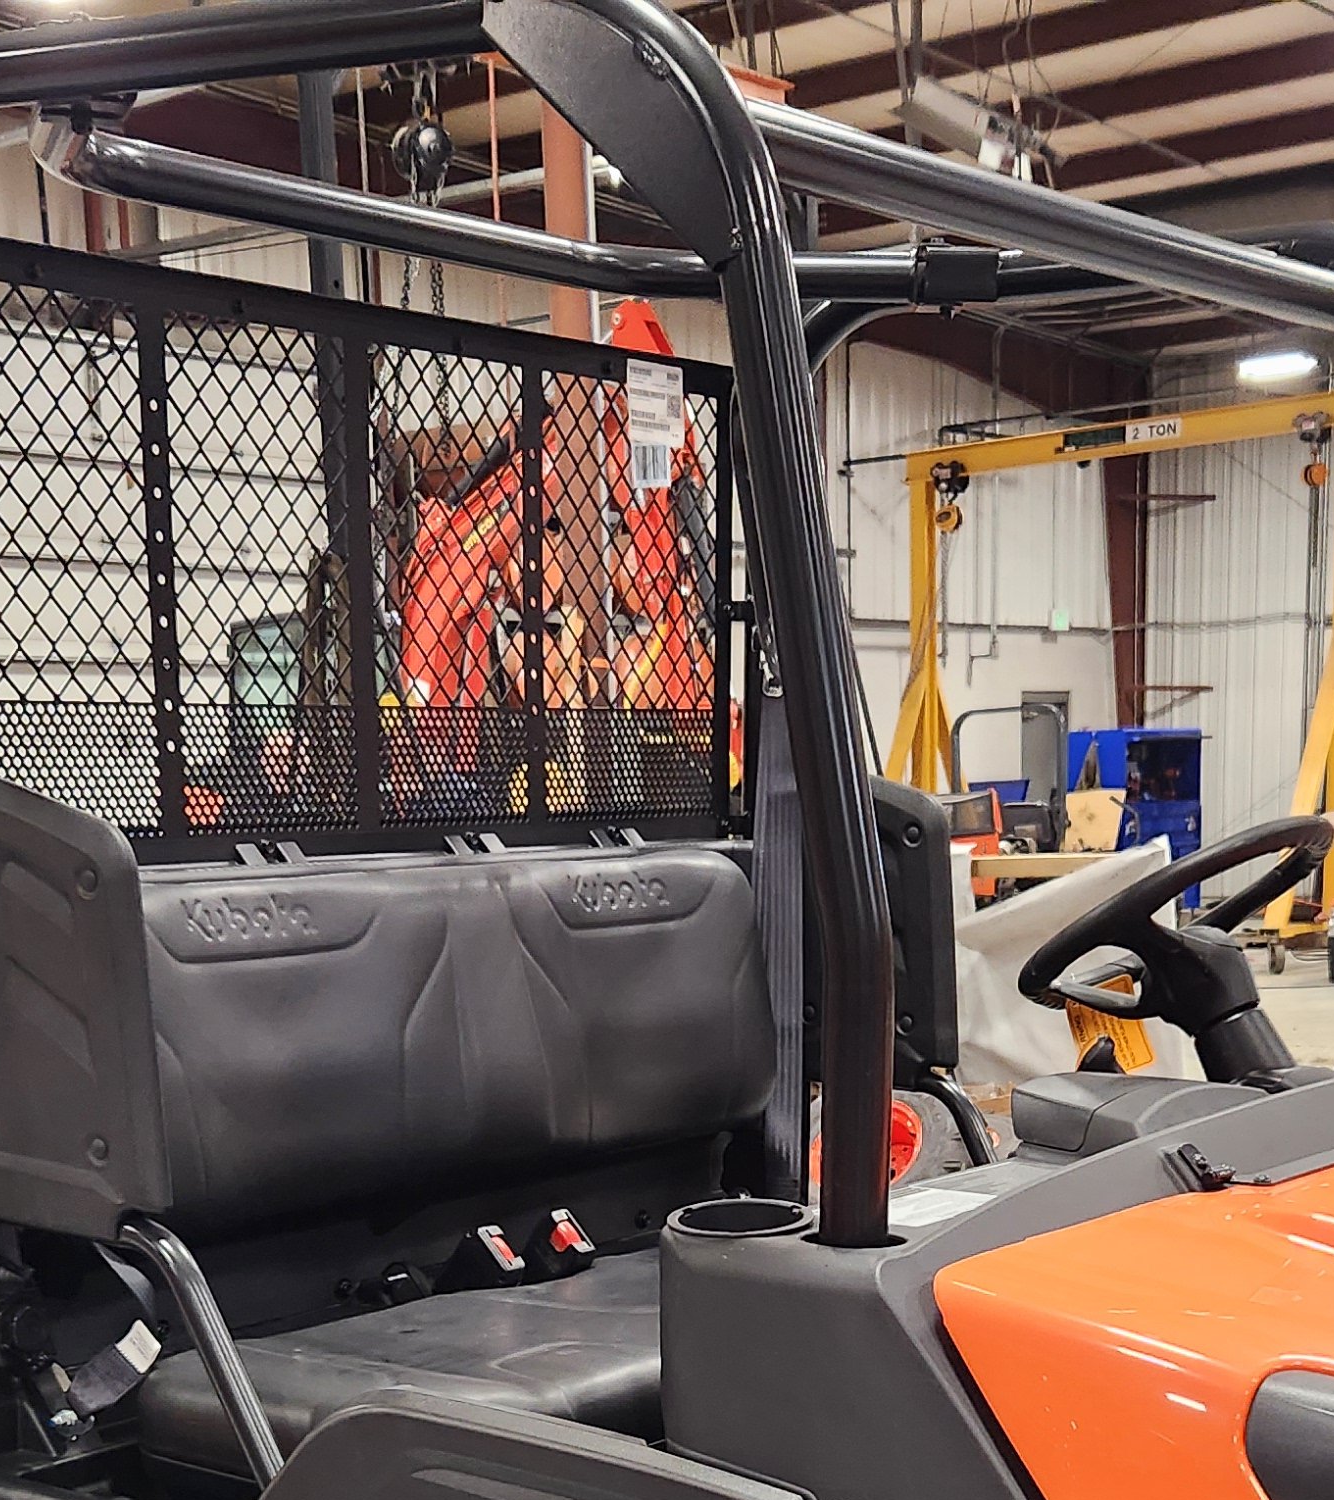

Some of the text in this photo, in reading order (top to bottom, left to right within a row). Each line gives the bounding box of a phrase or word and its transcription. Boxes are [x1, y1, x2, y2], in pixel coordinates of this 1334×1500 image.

[1132, 423, 1177, 440] 2 TON
[566, 870, 671, 913] Kubota
[179, 892, 320, 943] Kubota
